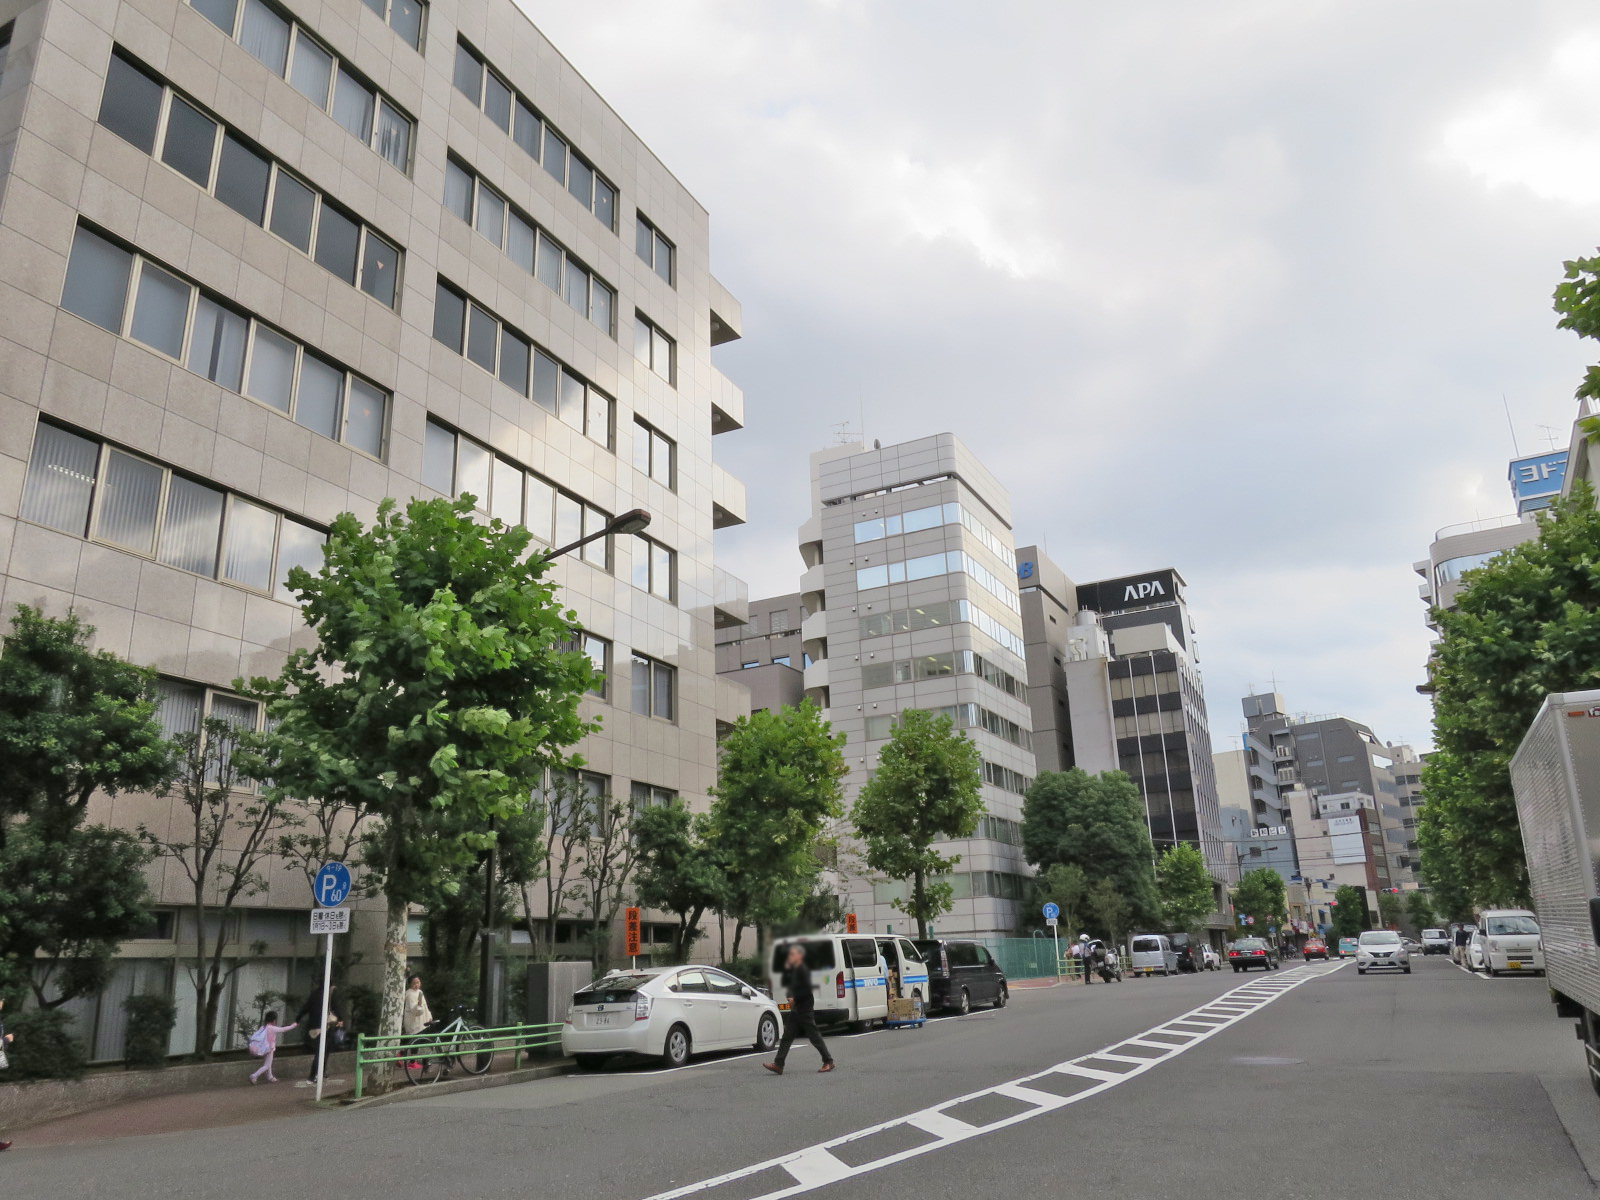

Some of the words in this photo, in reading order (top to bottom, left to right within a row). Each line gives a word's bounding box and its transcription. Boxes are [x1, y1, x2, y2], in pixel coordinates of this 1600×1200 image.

[1123, 580, 1166, 602] APA
[321, 874, 337, 903] P
[330, 889, 342, 902] 60
[628, 910, 638, 953] 段差注意
